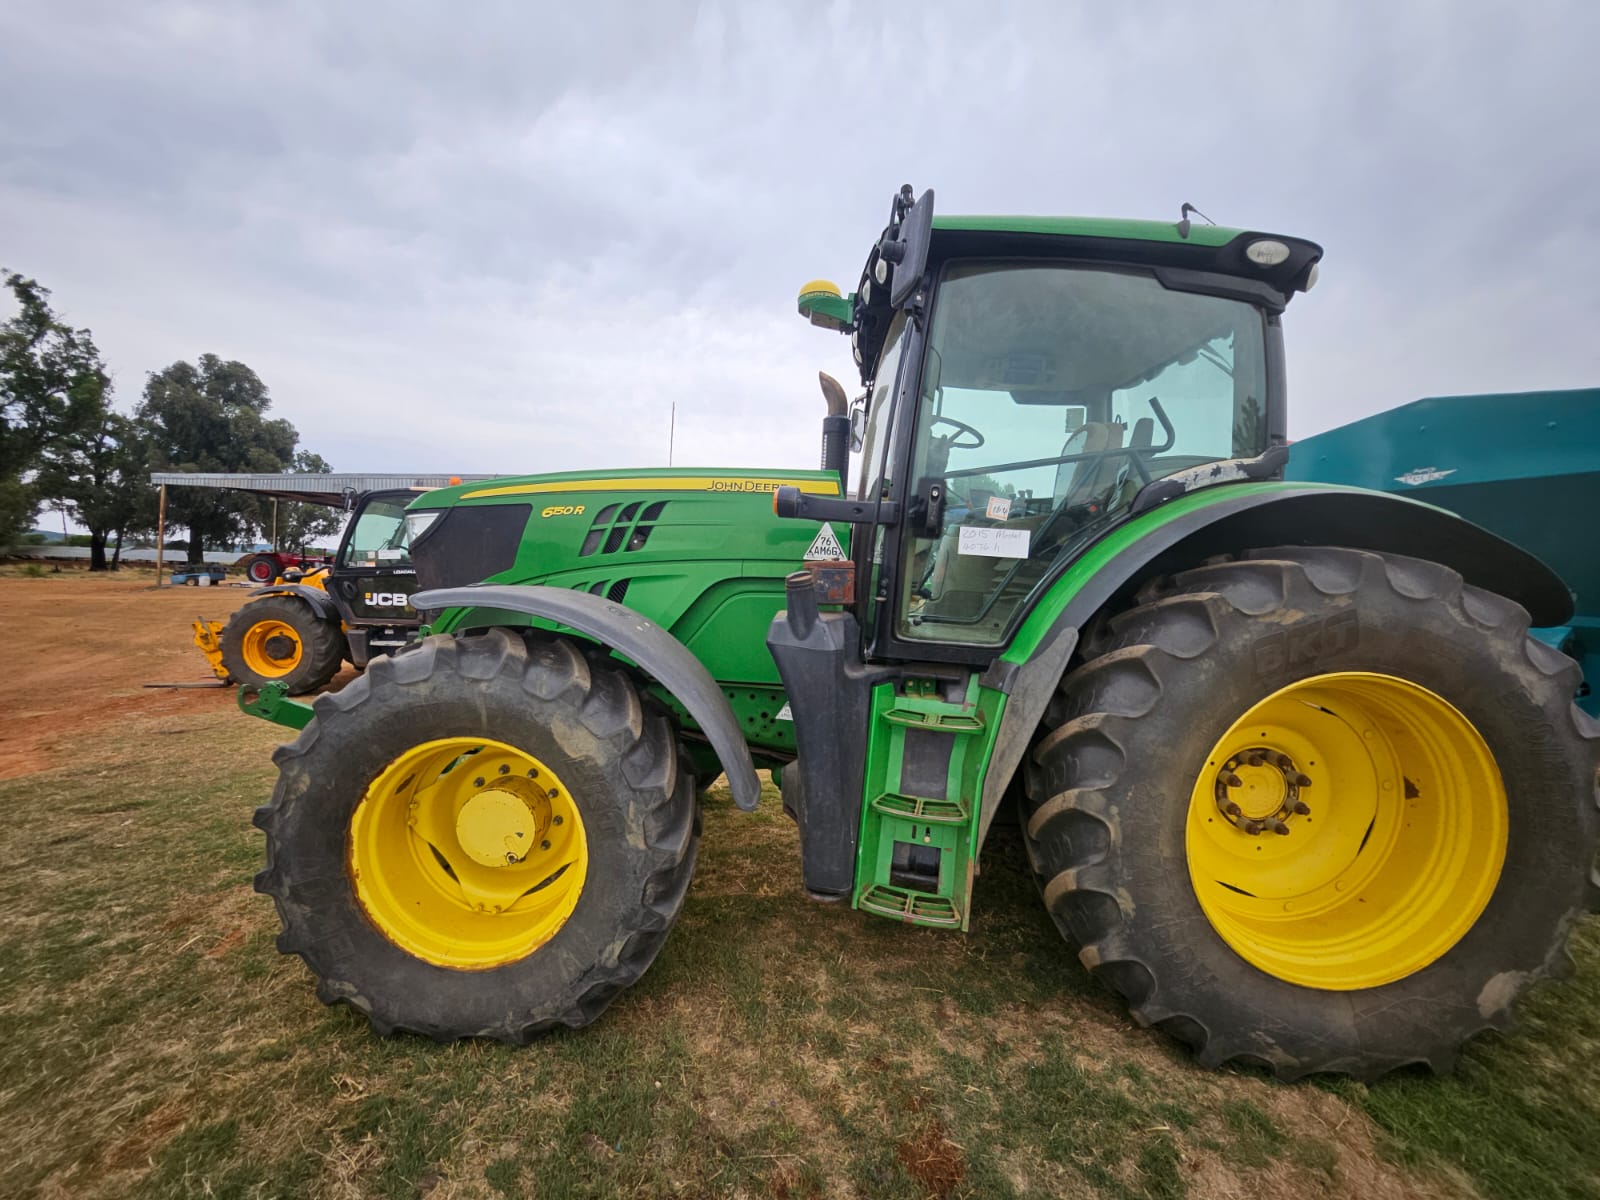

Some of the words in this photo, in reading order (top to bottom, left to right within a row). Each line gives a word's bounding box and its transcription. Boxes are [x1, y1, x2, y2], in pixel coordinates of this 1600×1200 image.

[707, 480, 743, 490] JOHN
[745, 481, 788, 491] DEER
[821, 536, 832, 545] 76
[364, 592, 408, 606] JCB
